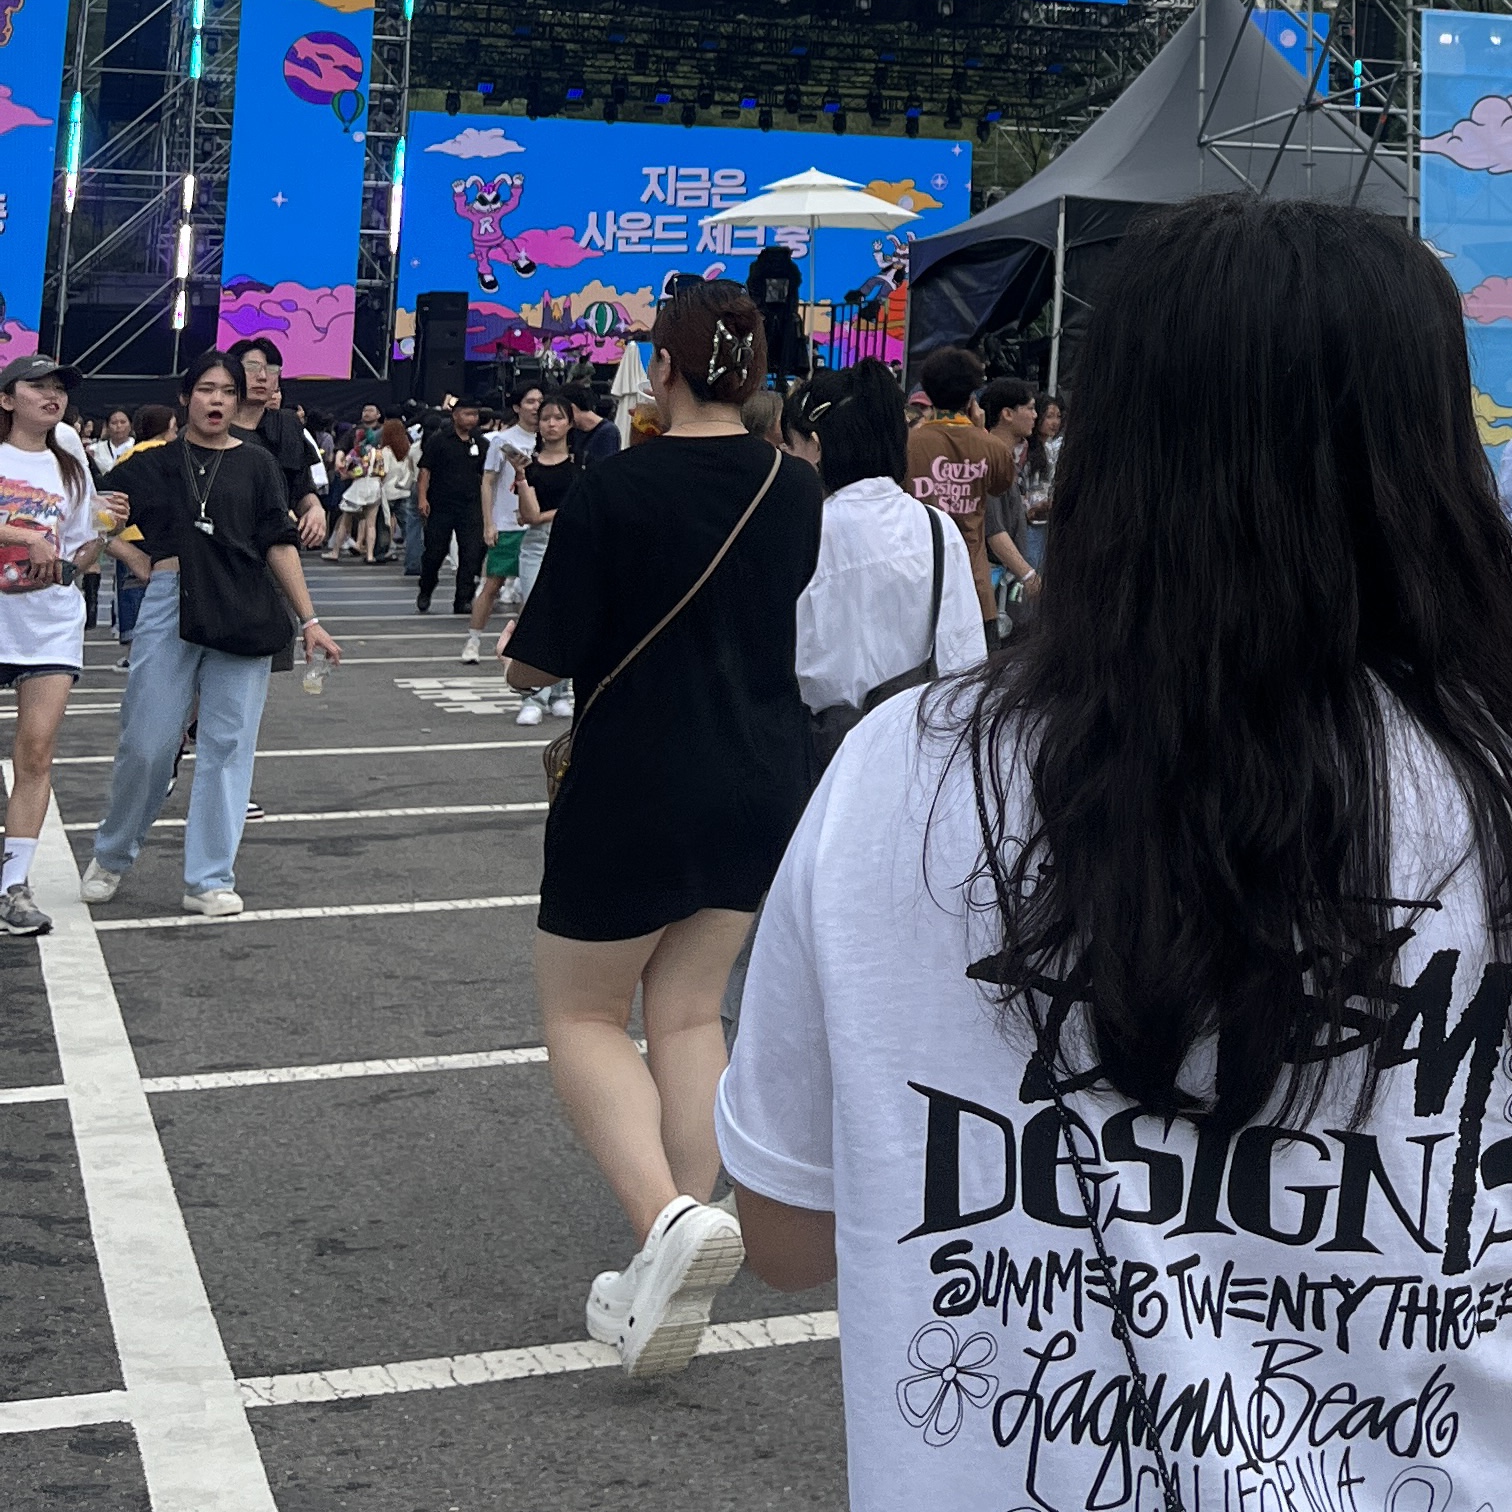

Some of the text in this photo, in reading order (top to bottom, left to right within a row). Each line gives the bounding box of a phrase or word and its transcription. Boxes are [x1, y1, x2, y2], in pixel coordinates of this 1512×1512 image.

[640, 165, 747, 209] 지금은
[479, 216, 496, 236] R
[579, 209, 688, 254] 사운드
[929, 1240, 1168, 1339] SUMMER
[1166, 1253, 1366, 1353] TWENTY
